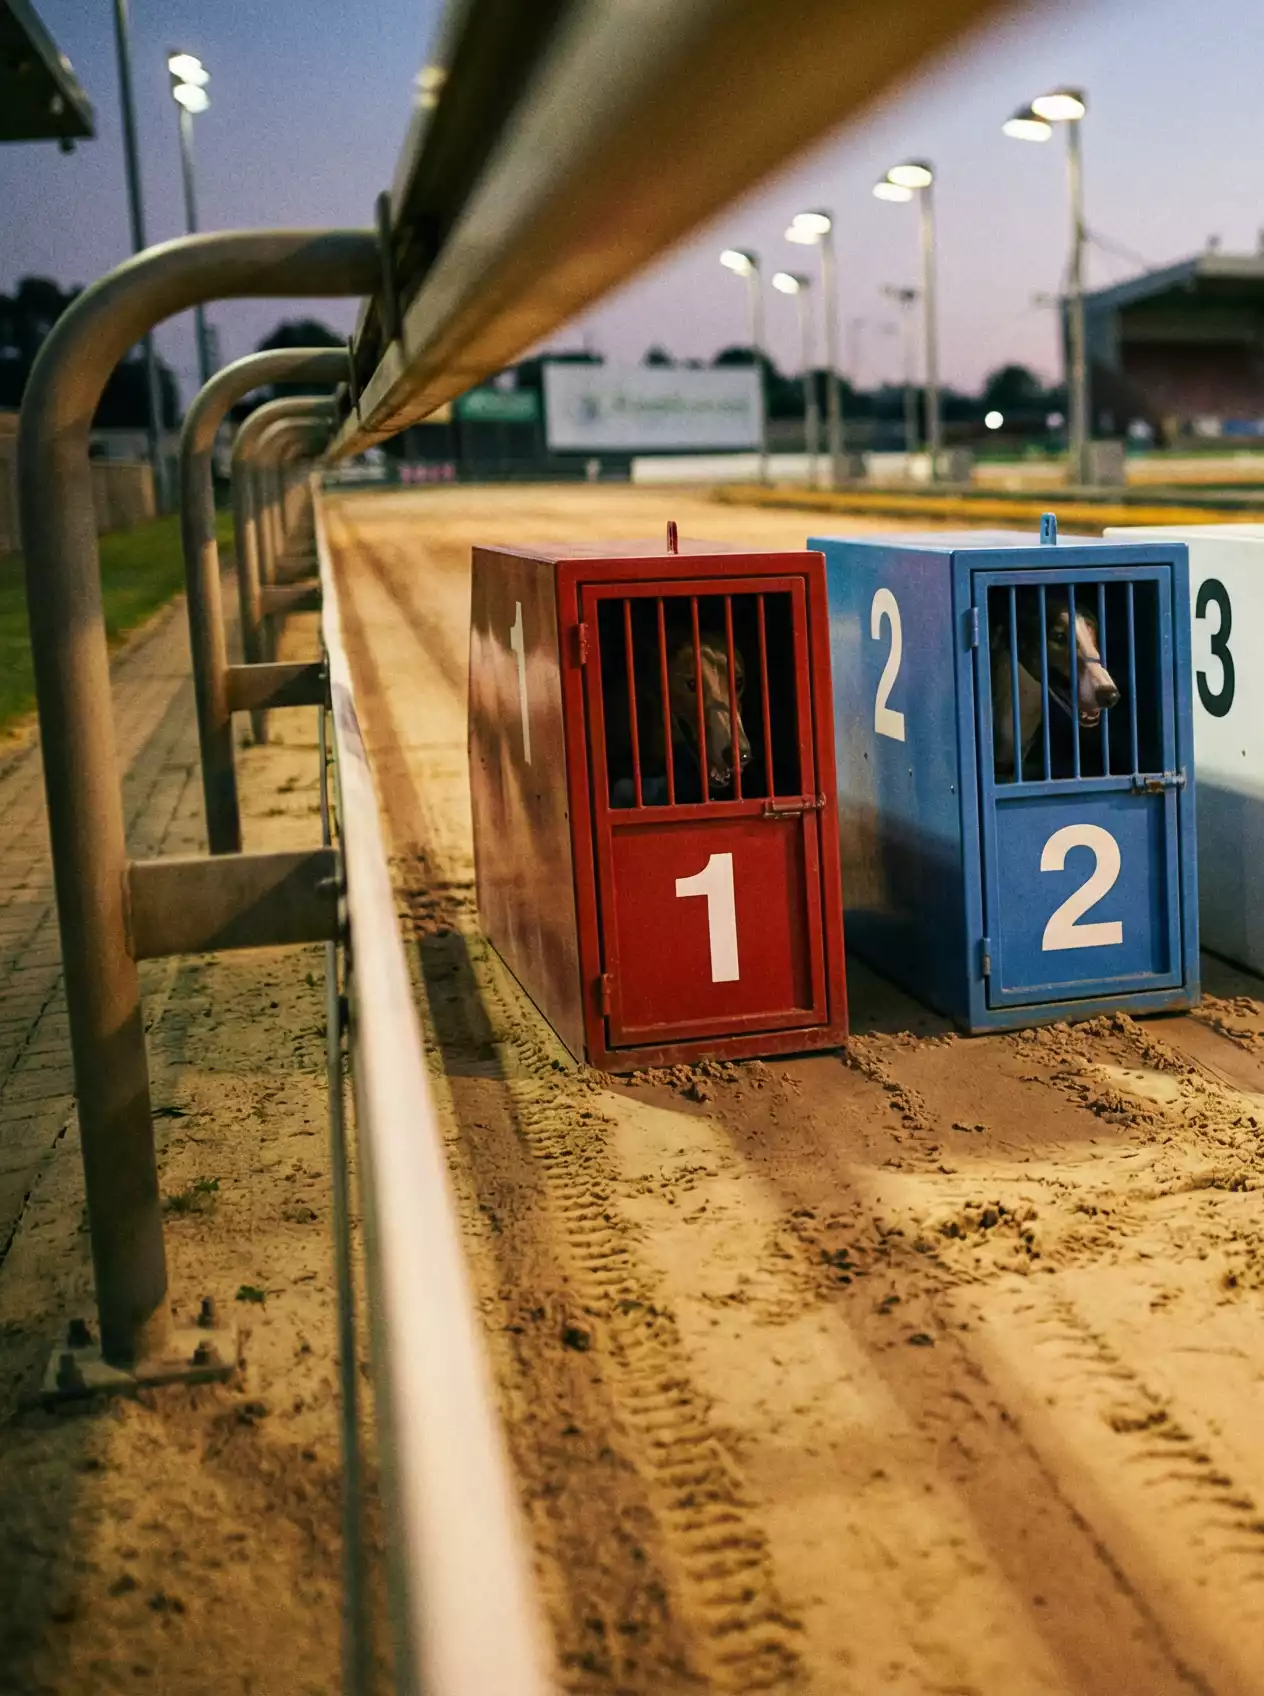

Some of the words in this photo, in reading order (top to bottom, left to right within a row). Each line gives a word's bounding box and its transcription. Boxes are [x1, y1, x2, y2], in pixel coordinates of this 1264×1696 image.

[510, 601, 531, 766] 1
[870, 587, 906, 741] 2
[1195, 578, 1235, 717] 3
[675, 852, 740, 983] 1
[1040, 823, 1123, 951] 2
